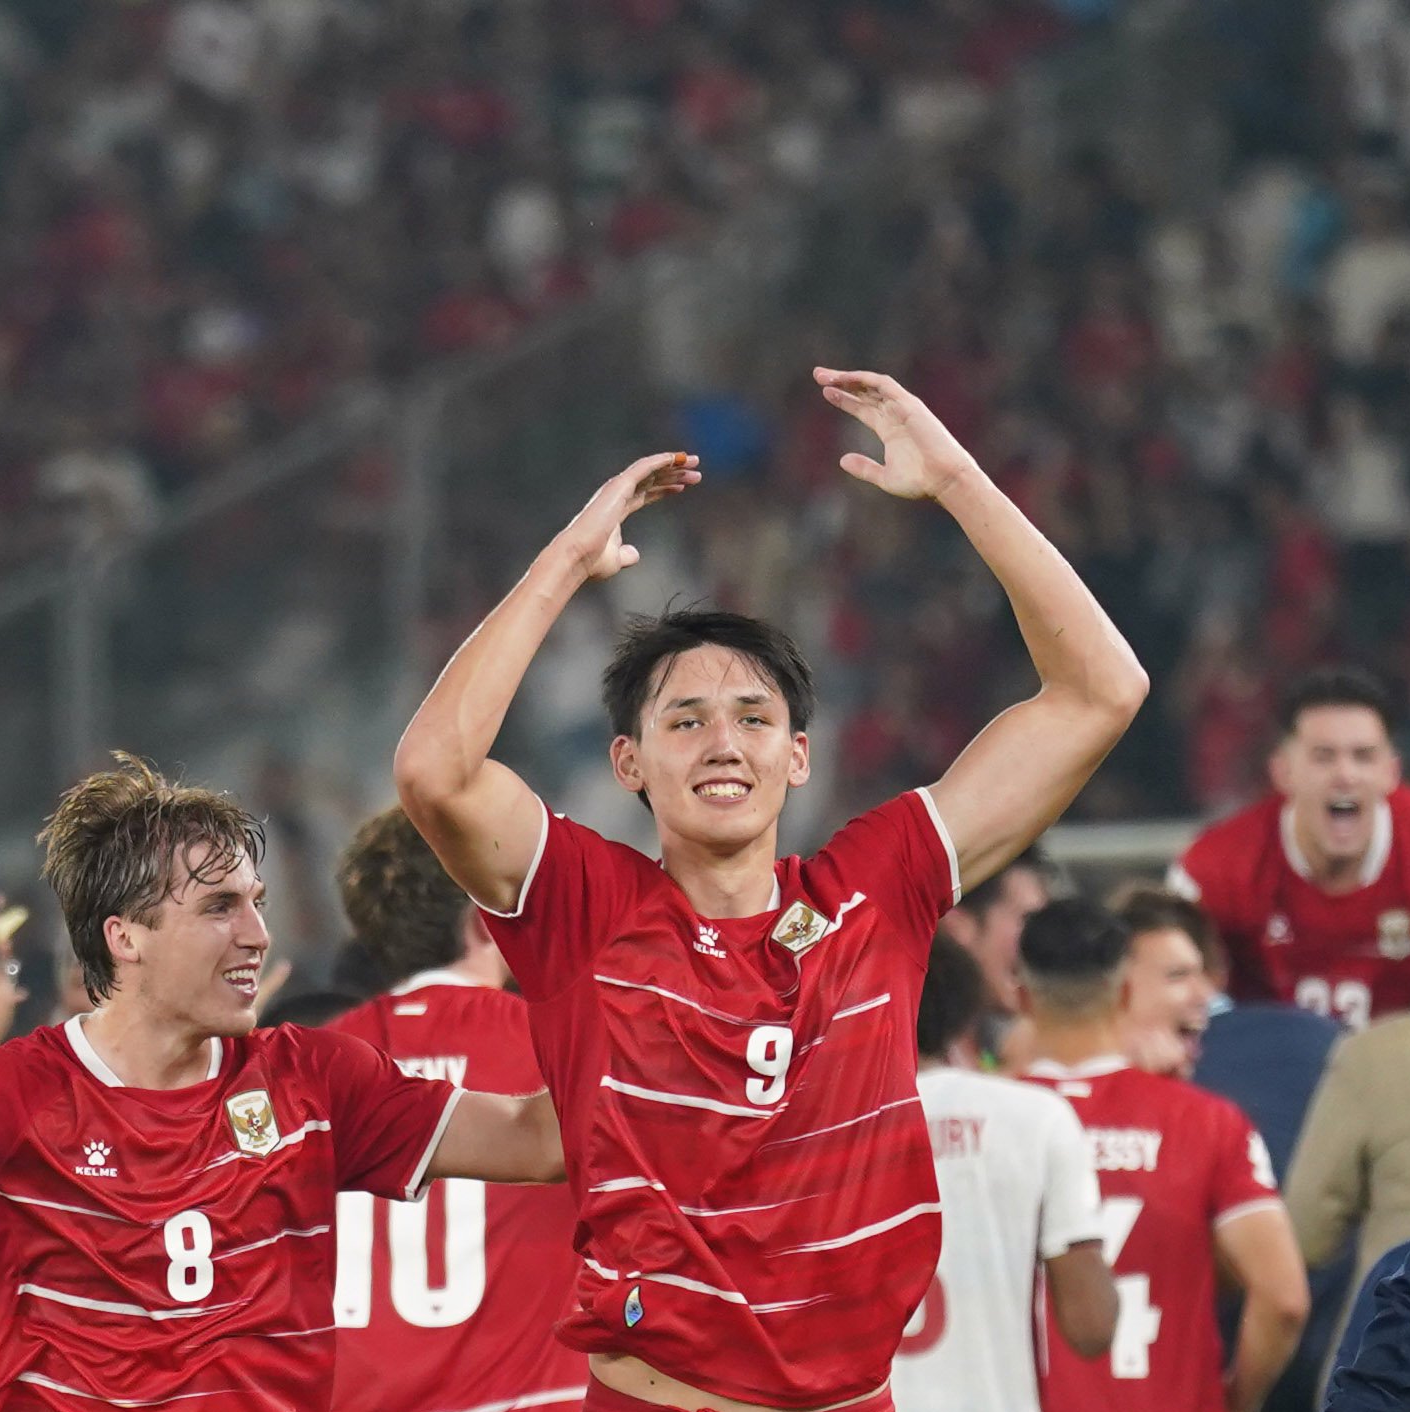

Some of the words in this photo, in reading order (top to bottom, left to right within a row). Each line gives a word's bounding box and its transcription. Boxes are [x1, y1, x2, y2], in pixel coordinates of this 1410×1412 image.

[745, 1025, 794, 1106] 9
[75, 1166, 118, 1178] KELME
[163, 1209, 215, 1303] 8
[334, 1177, 486, 1328] 10
